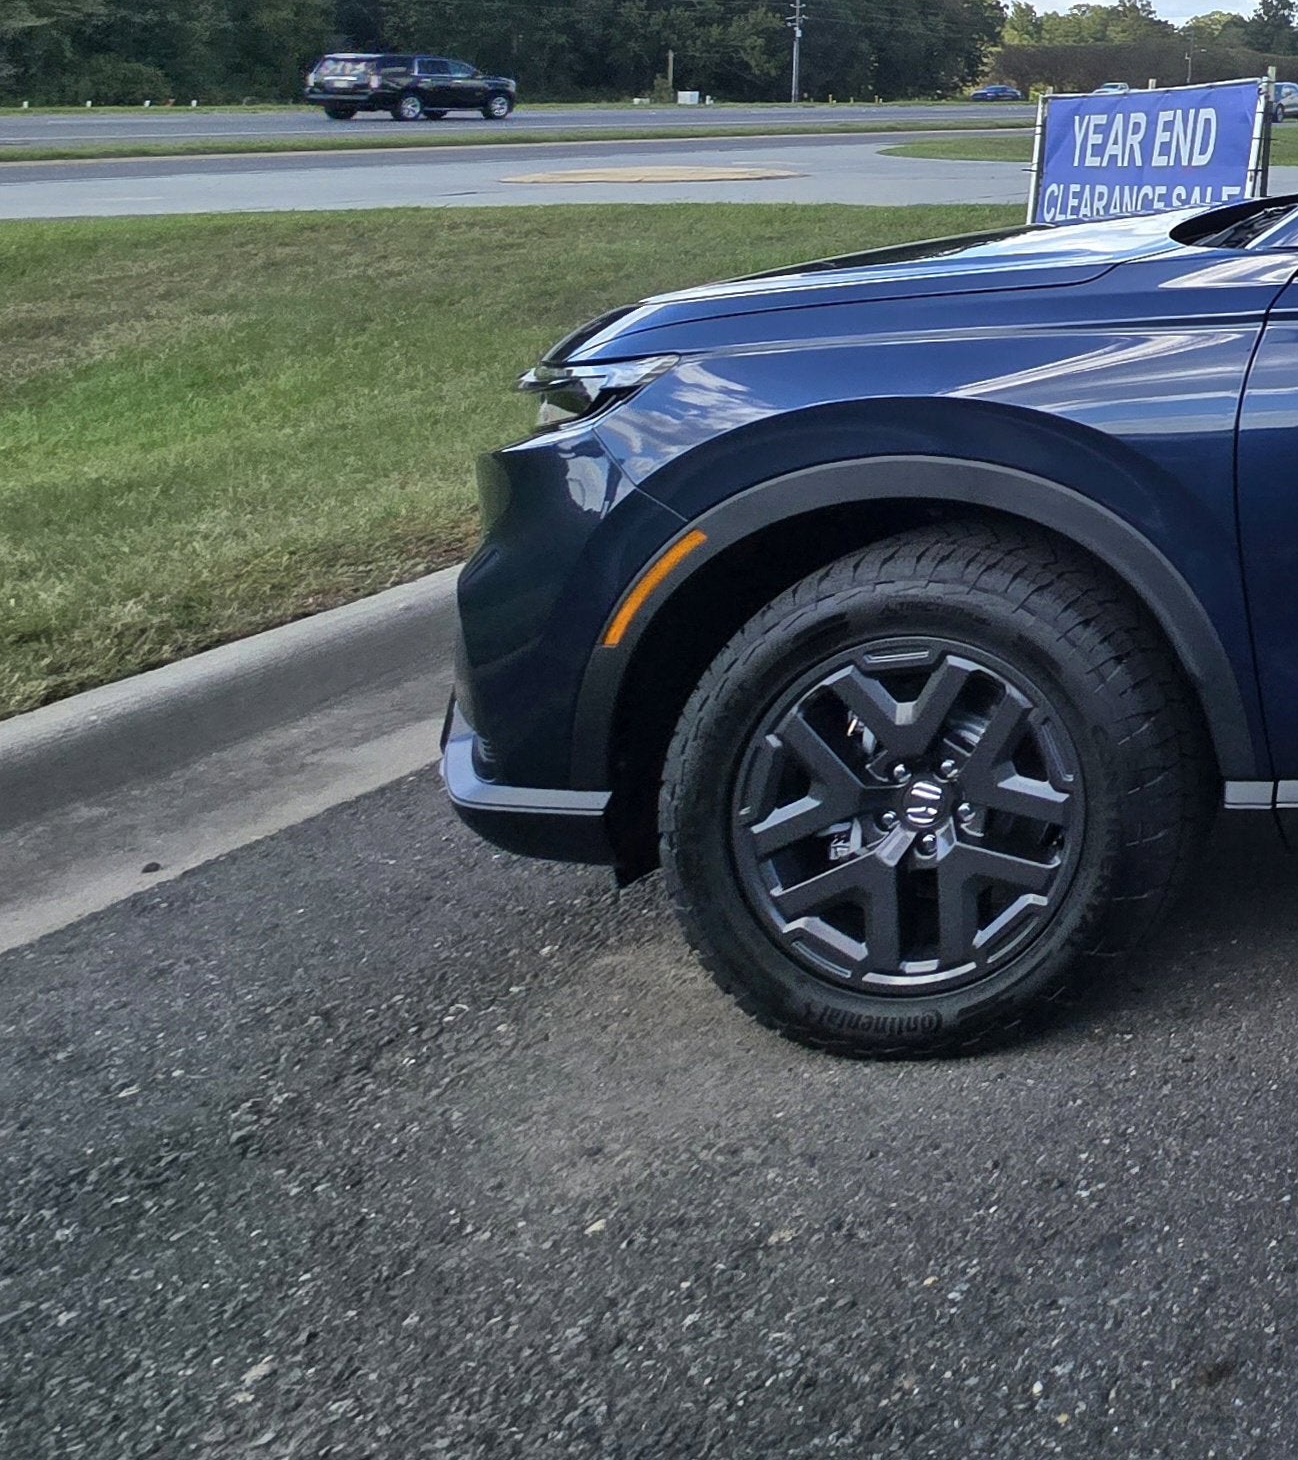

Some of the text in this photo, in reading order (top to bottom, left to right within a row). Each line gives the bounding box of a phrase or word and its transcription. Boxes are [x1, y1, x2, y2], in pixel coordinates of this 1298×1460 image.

[1072, 107, 1218, 168] YEAR END
[1042, 182, 1168, 223] CLEARANCE
